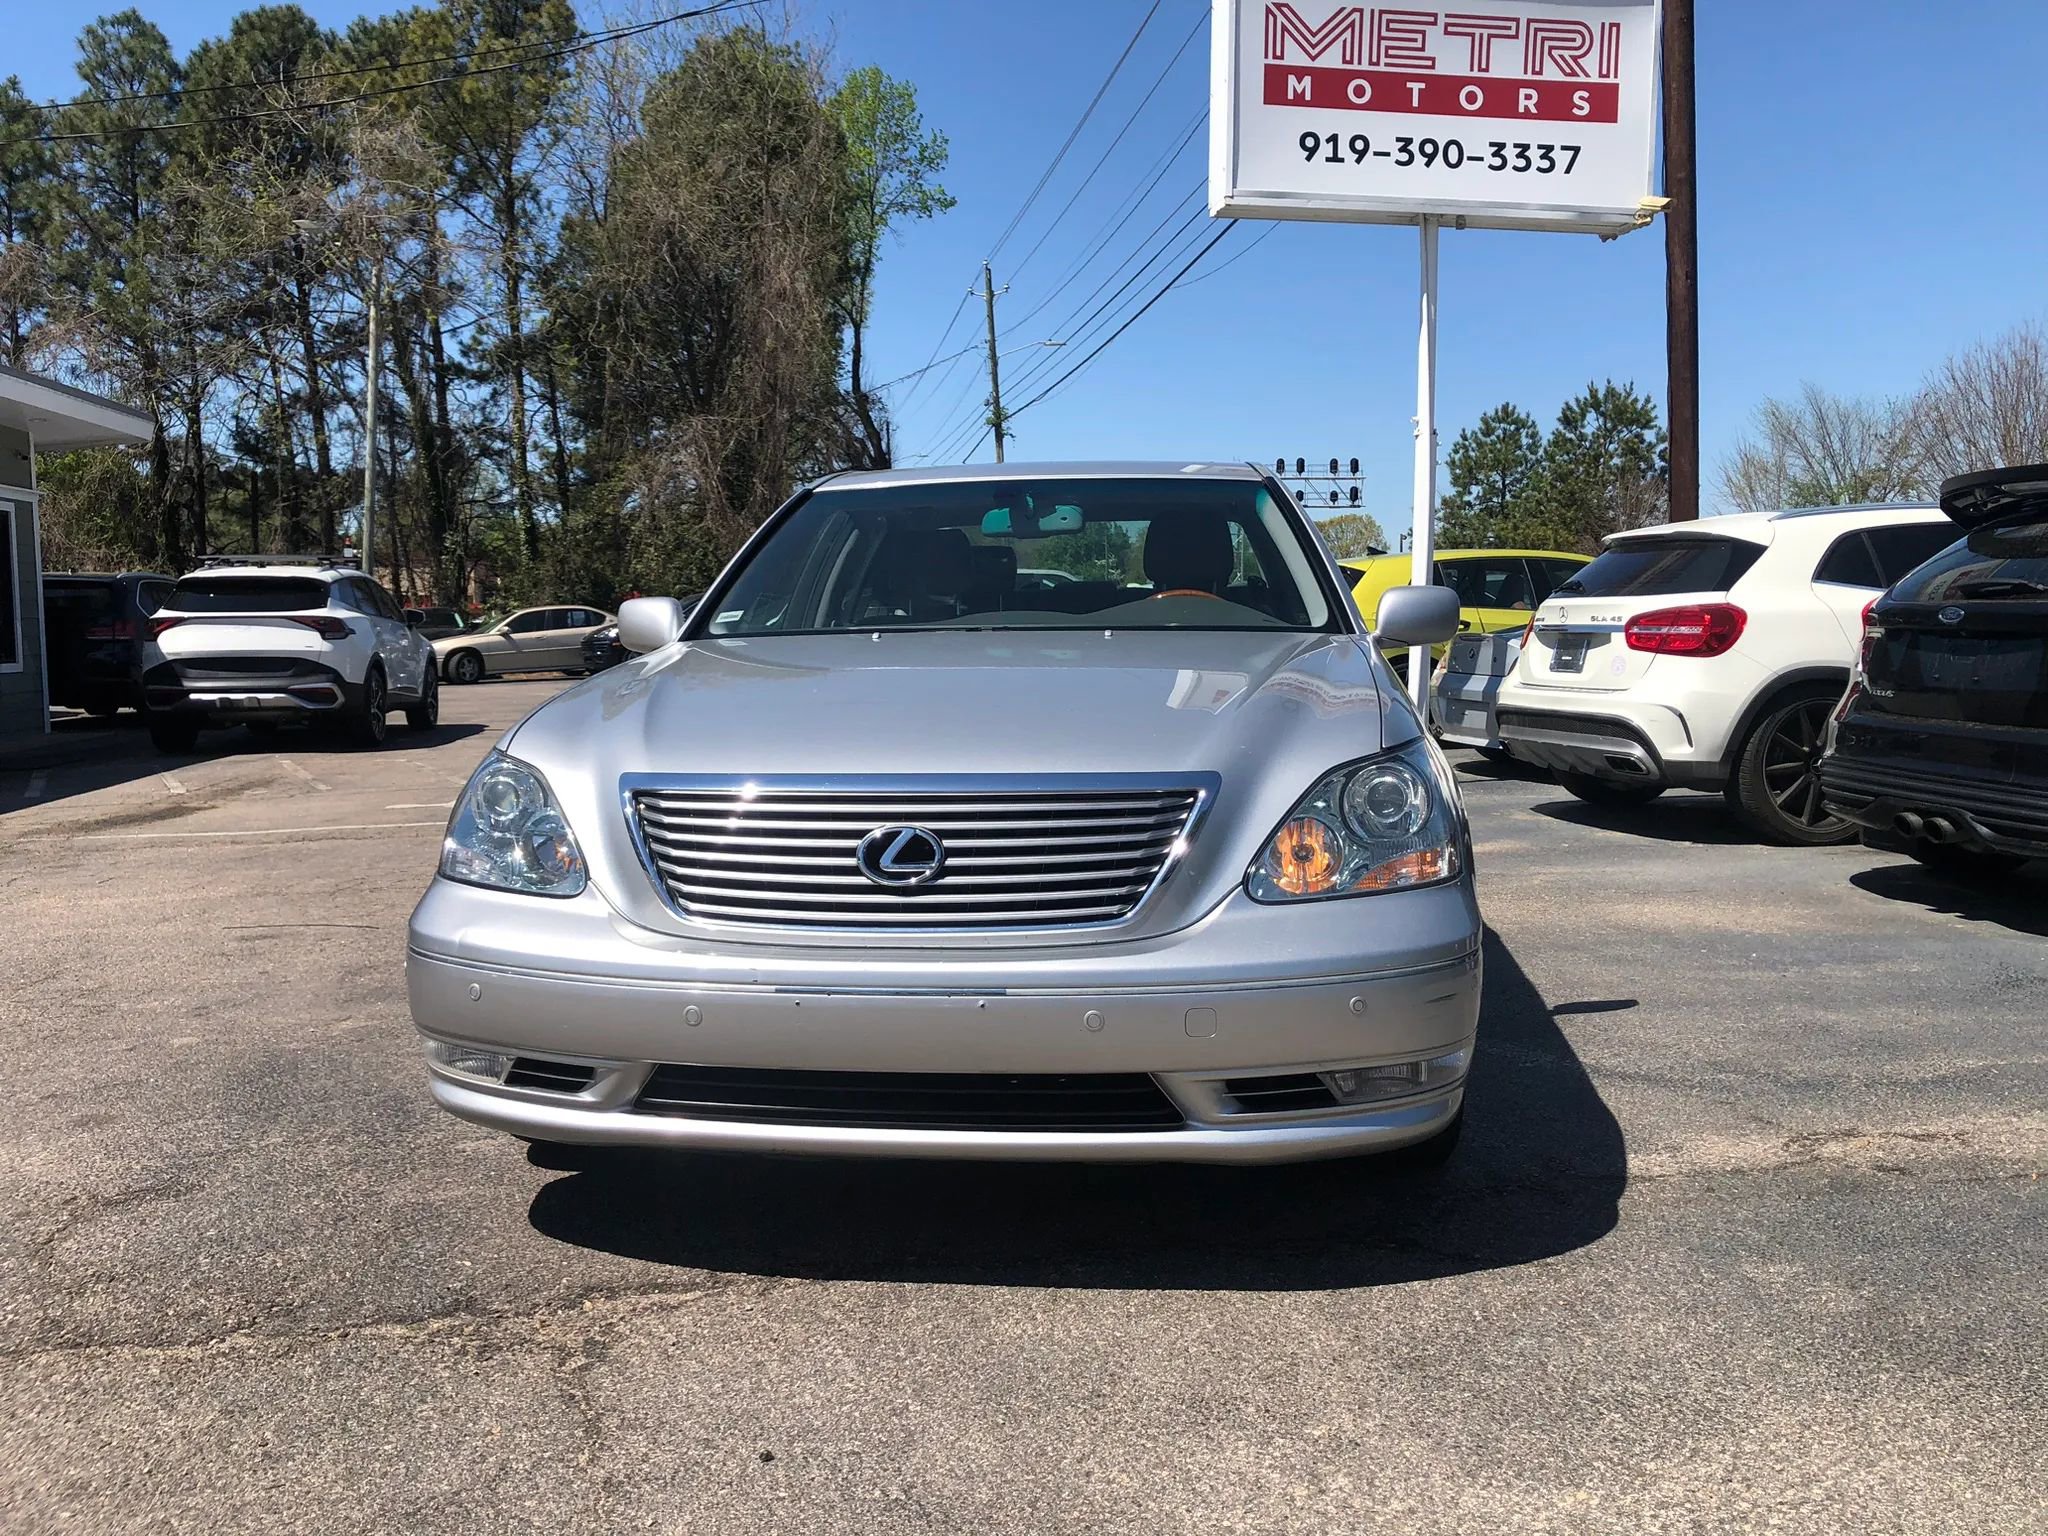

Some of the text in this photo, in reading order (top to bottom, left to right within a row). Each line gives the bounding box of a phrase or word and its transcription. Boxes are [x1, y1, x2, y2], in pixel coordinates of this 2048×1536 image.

[1264, 1, 1620, 79] METRI
[1287, 74, 1591, 116] MOTORS
[1299, 131, 1582, 175] 919-390-3337
